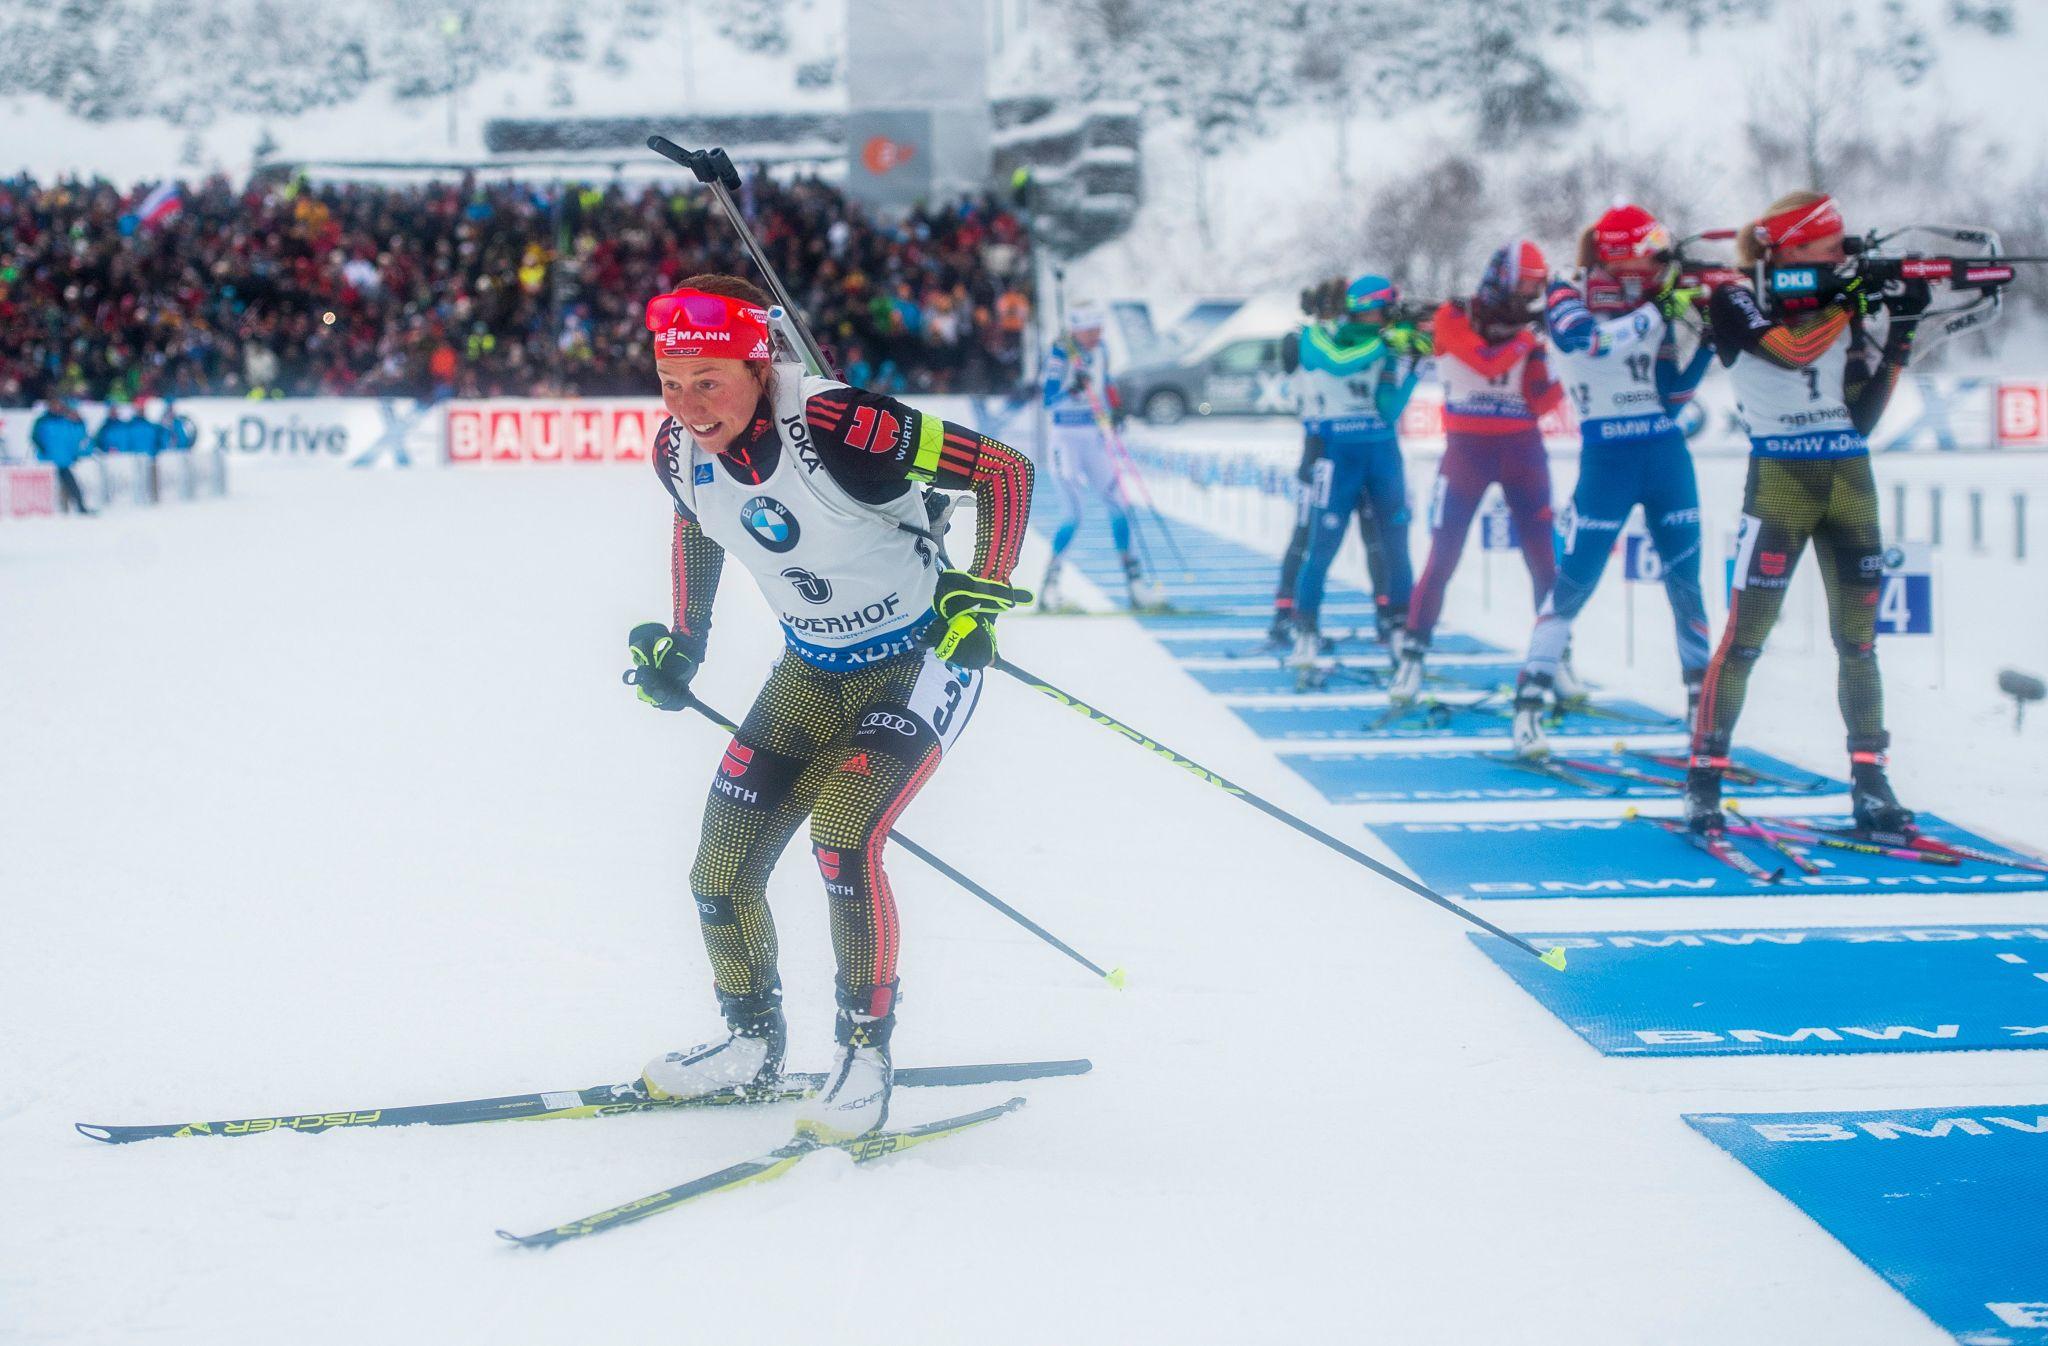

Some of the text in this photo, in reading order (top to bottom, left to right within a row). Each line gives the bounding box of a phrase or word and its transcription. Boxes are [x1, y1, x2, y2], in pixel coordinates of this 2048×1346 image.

[1776, 271, 1814, 288] DKB
[213, 413, 348, 452] xDrive
[895, 415, 913, 461] WÜRTH
[1601, 420, 1650, 439] BMW
[668, 425, 684, 483] JOKA
[781, 414, 822, 475] JOKA
[1766, 436, 1825, 452] BMW
[742, 498, 788, 519] BMW
[1878, 576, 1912, 634] 4
[713, 775, 758, 804] ÜRTH
[825, 884, 854, 896] RTH
[1470, 877, 1717, 893] BMW
[1530, 931, 1805, 950] BMW
[1634, 1024, 1960, 1045] BMW
[223, 1110, 381, 1133] FISCHER
